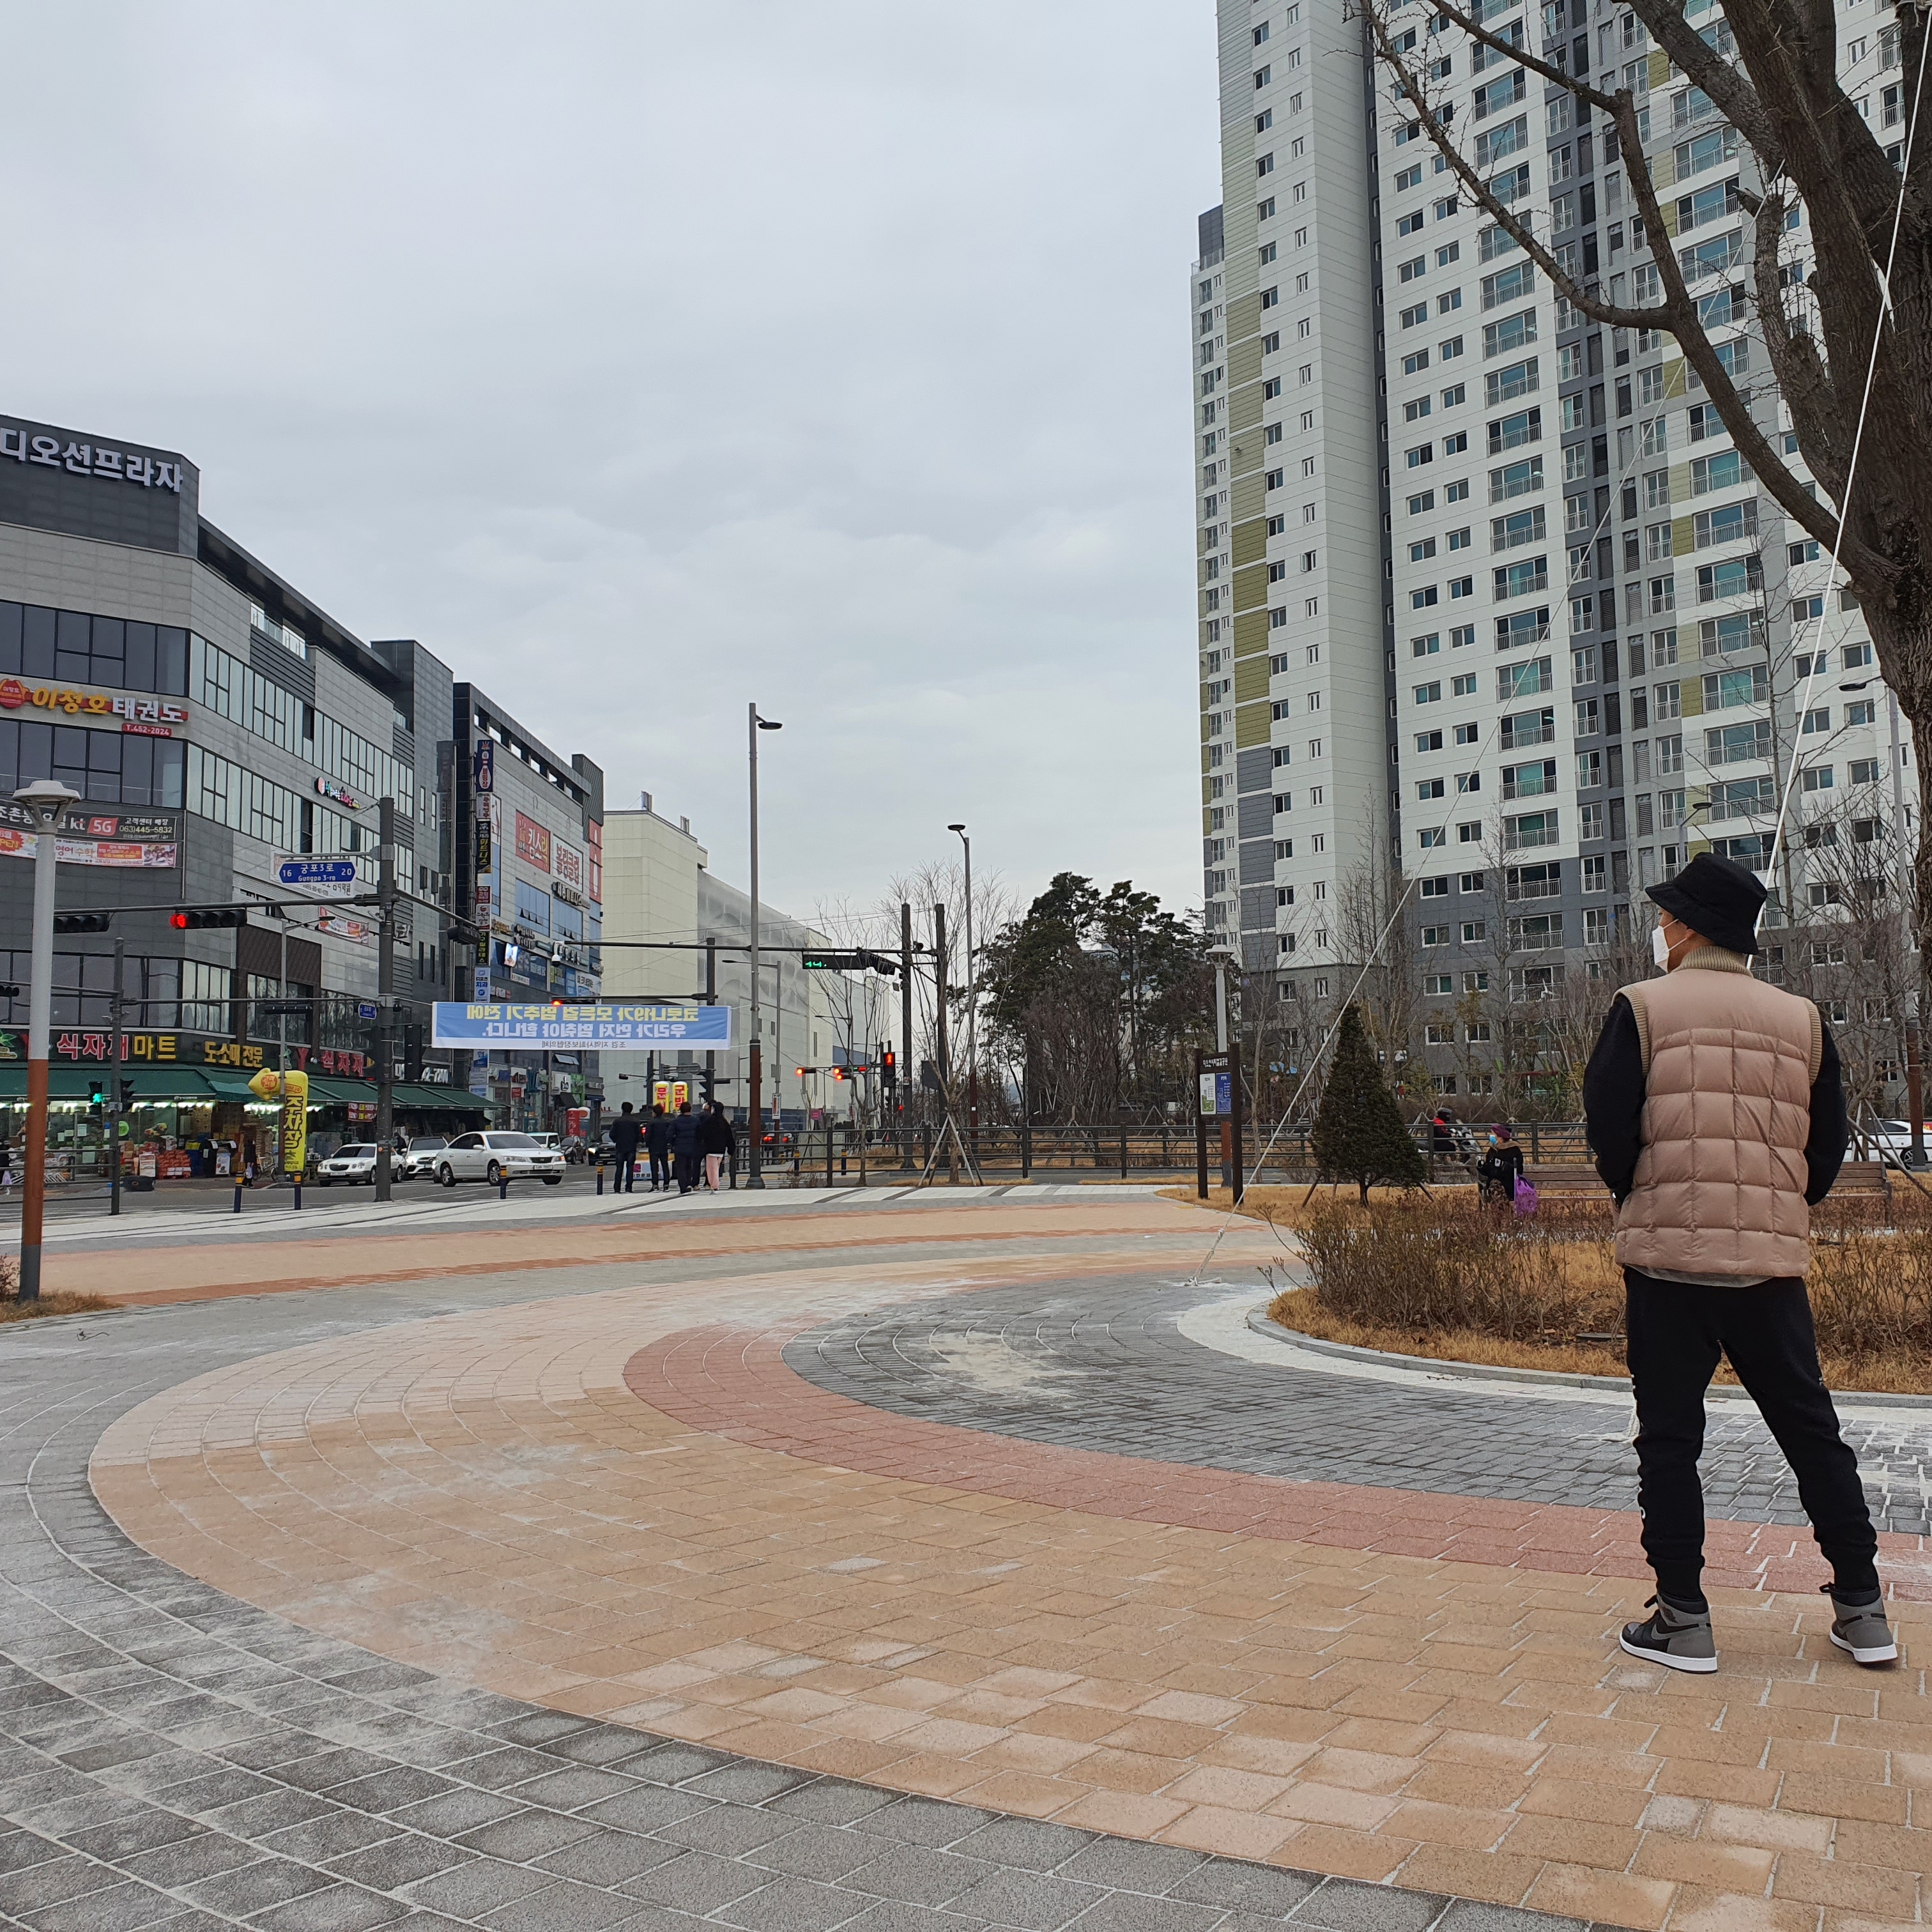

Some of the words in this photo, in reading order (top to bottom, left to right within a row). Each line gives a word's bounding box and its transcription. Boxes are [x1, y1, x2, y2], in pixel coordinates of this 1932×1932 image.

[0, 427, 183, 493] 디오션프라자
[32, 687, 108, 714] 이정호
[112, 696, 184, 723] 태권도
[70, 817, 86, 830] kt
[93, 820, 112, 832] 5G
[300, 863, 334, 874] 궁포3로
[57, 1033, 128, 1061] 식자재
[133, 1035, 176, 1059] 마트
[204, 1040, 240, 1066] 도소매
[243, 1045, 263, 1068] 전문
[322, 1050, 364, 1077] 식자재
[284, 1095, 303, 1149] 주차장
